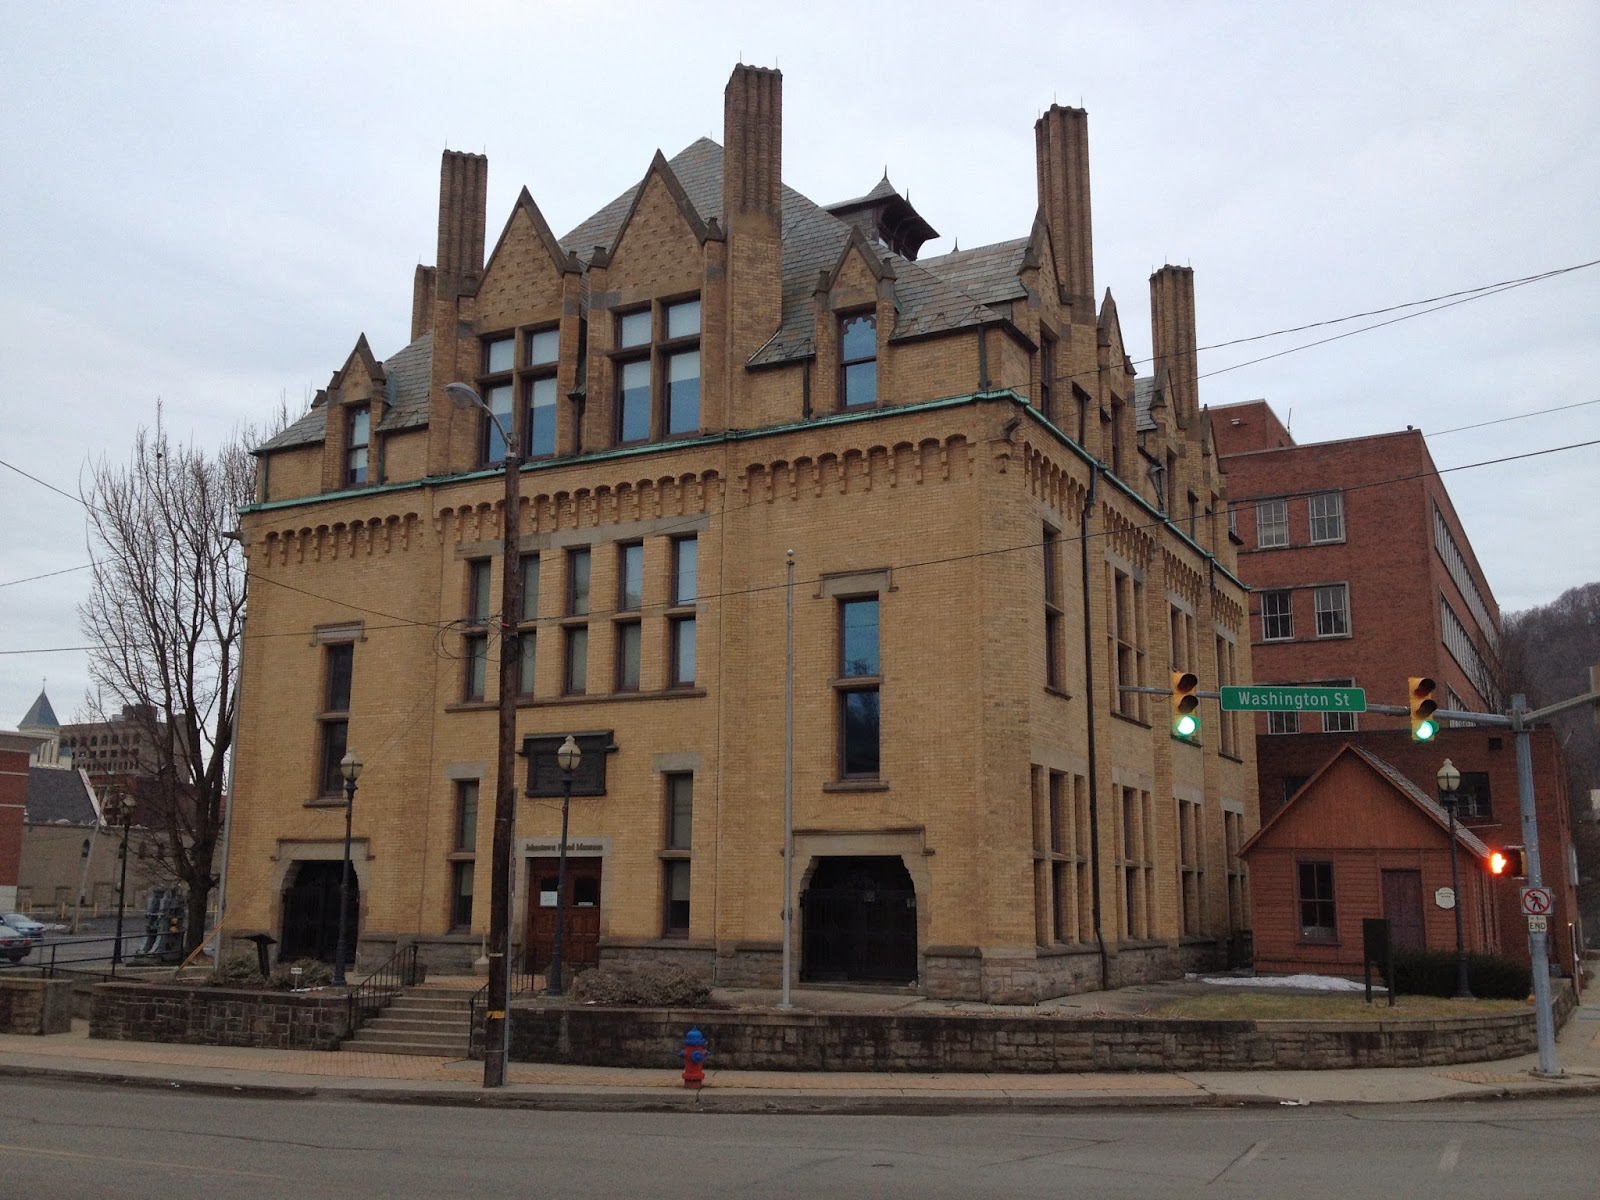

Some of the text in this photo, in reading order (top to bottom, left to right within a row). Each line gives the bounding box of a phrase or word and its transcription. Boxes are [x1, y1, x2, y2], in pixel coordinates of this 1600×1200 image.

[1238, 691, 1350, 709] Washington St
[576, 843, 603, 851] Museum
[1530, 922, 1546, 930] END
